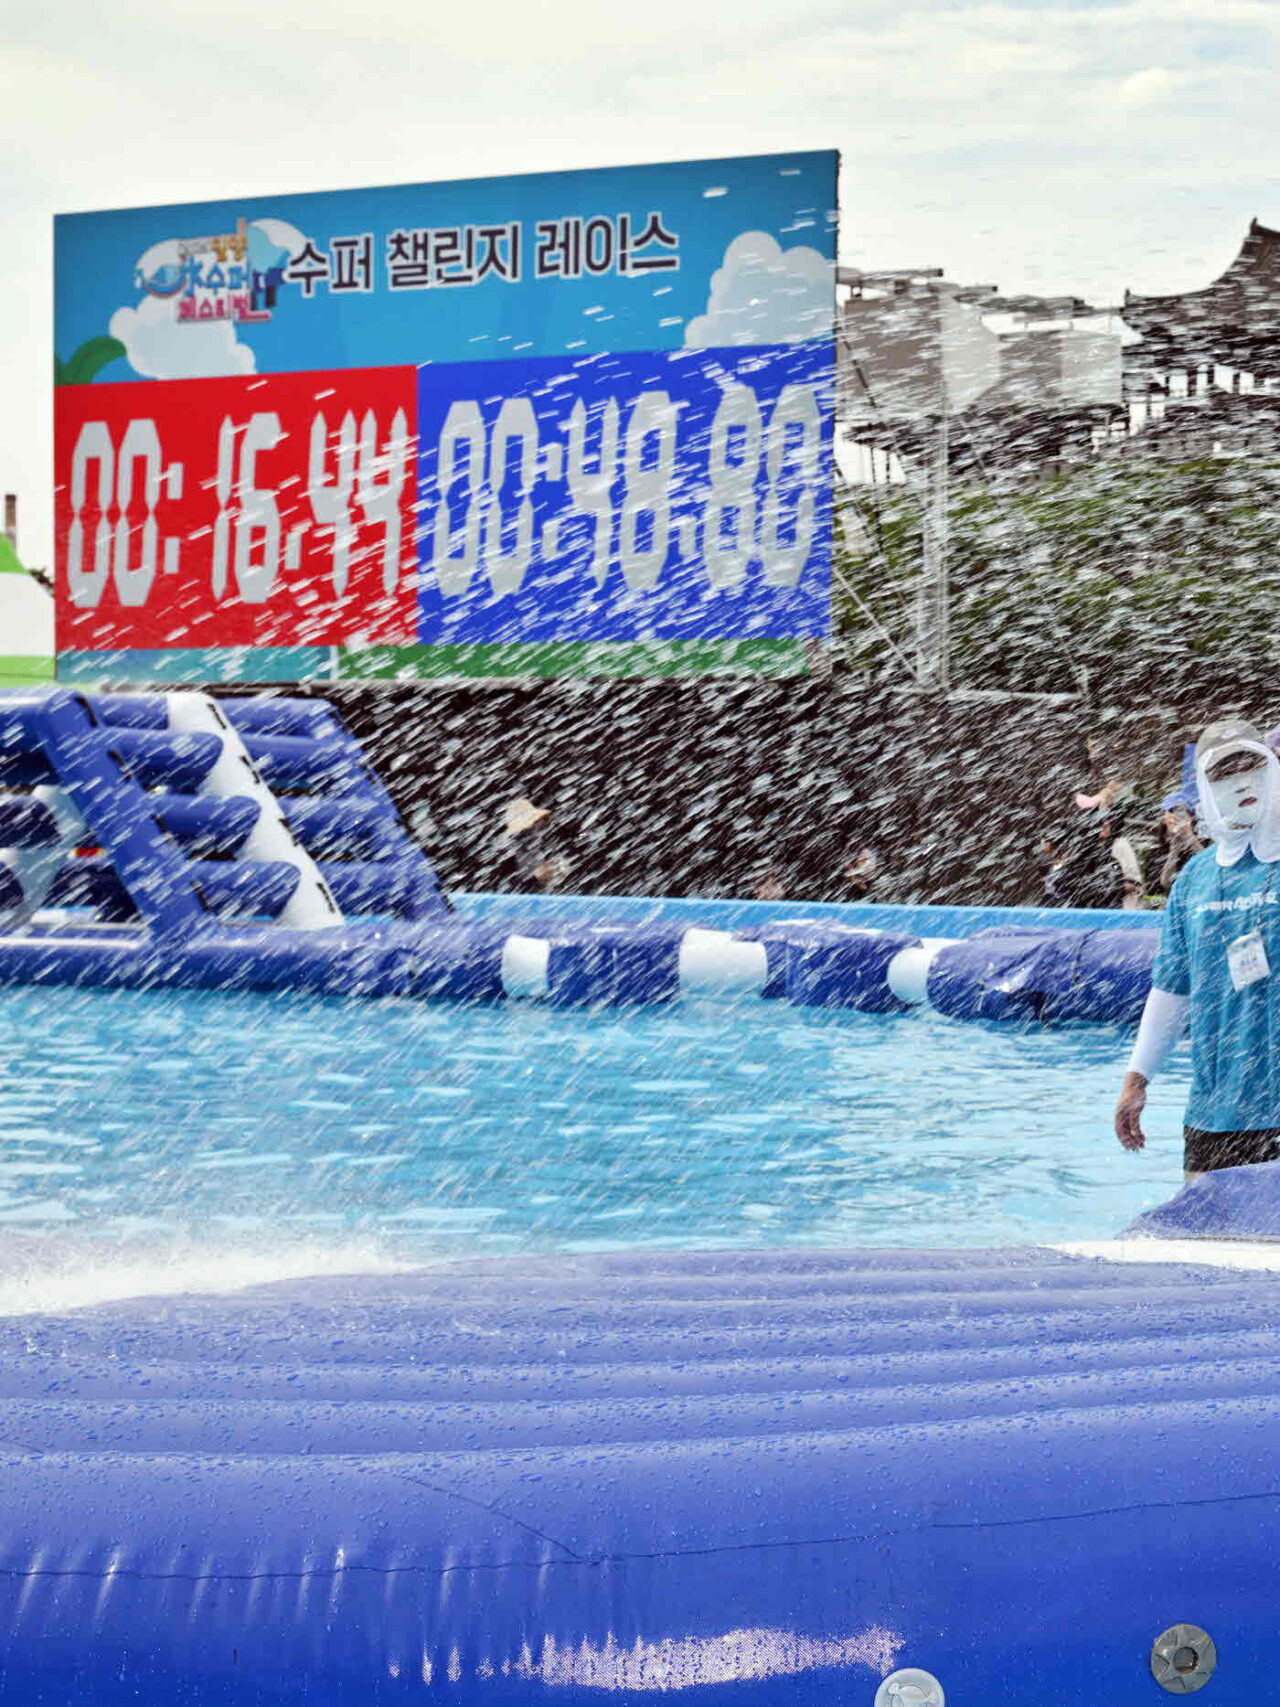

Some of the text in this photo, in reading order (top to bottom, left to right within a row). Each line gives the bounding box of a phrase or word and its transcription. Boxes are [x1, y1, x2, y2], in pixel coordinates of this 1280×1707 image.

[287, 213, 679, 295] 수퍼 챌린지 레이스
